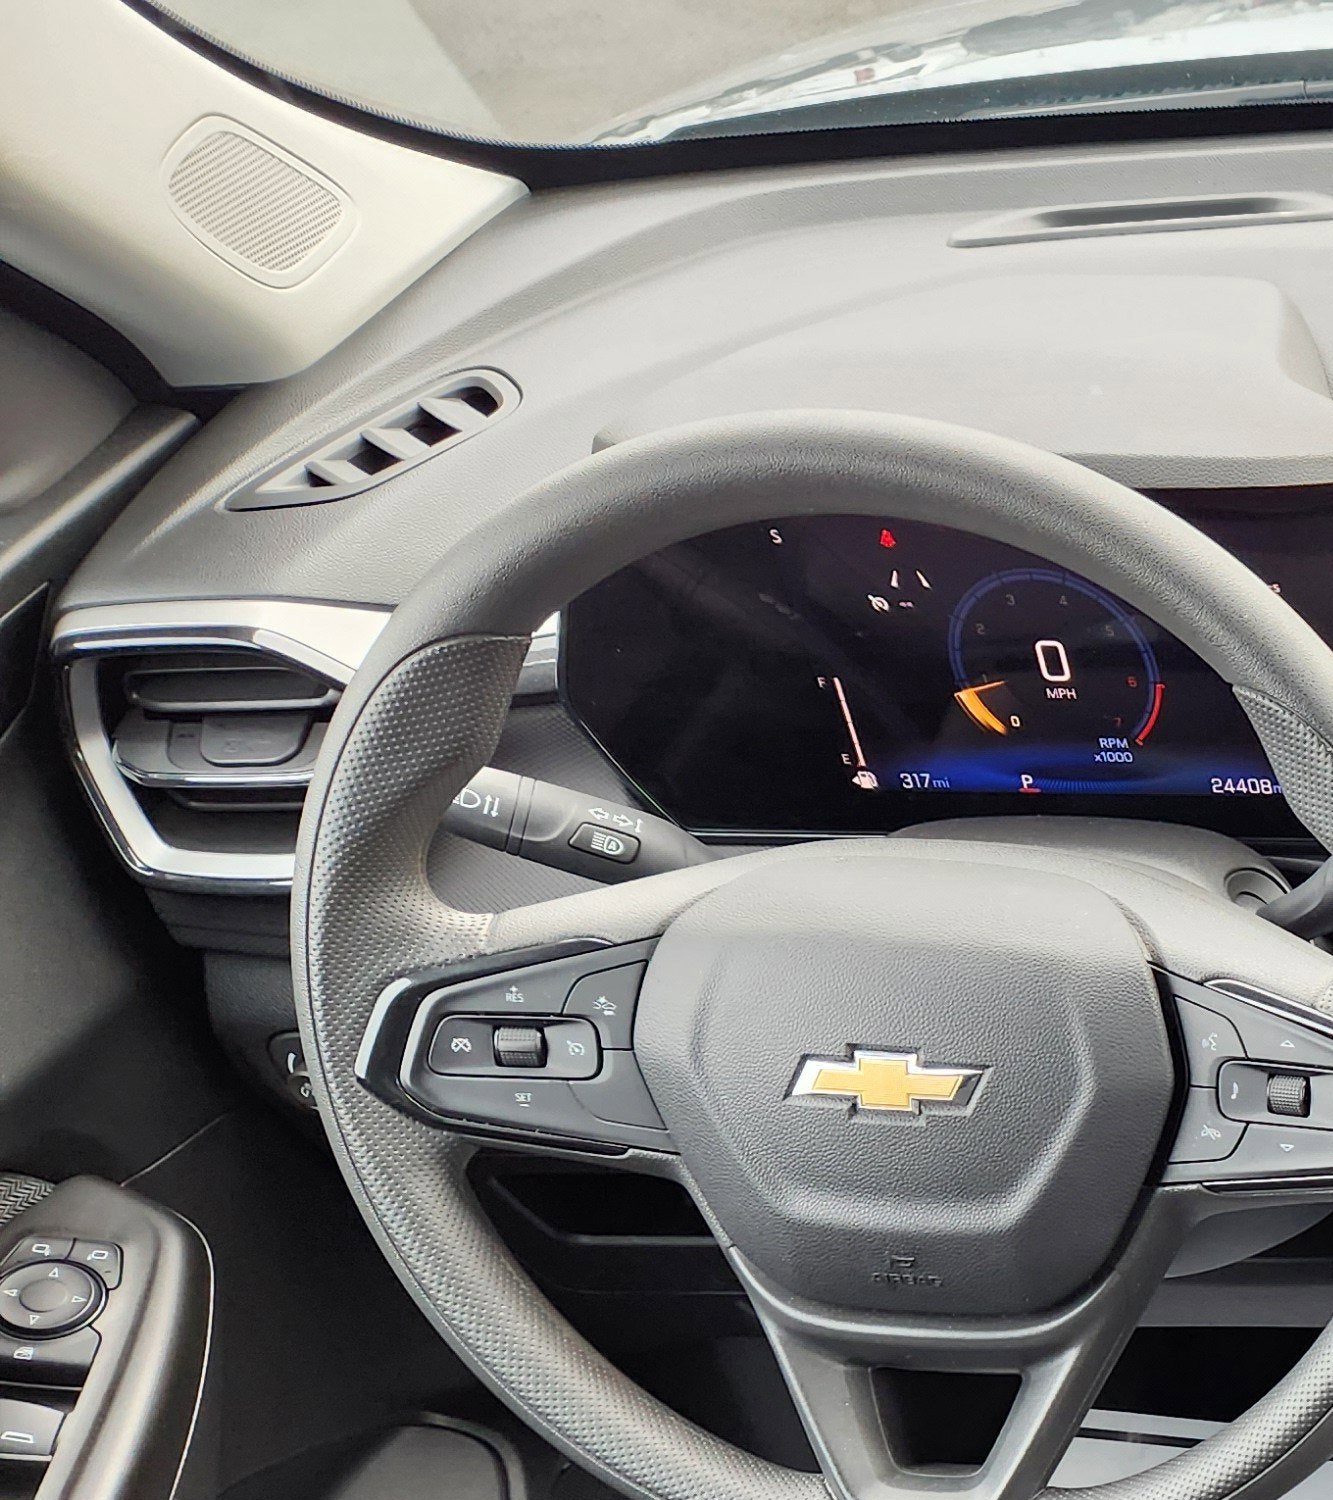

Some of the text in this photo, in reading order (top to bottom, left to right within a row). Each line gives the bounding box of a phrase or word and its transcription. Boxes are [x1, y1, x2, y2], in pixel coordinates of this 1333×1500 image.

[1035, 640, 1071, 682] 0
[817, 676, 827, 689] F
[1046, 687, 1077, 700] MPH
[1010, 715, 1021, 728] 0
[1099, 737, 1129, 750] RPM
[841, 753, 852, 765] E
[1094, 751, 1133, 764] x1000
[900, 773, 931, 789] 317
[1021, 774, 1033, 789] P
[506, 992, 524, 1003] RES
[514, 1092, 532, 1103] SET
